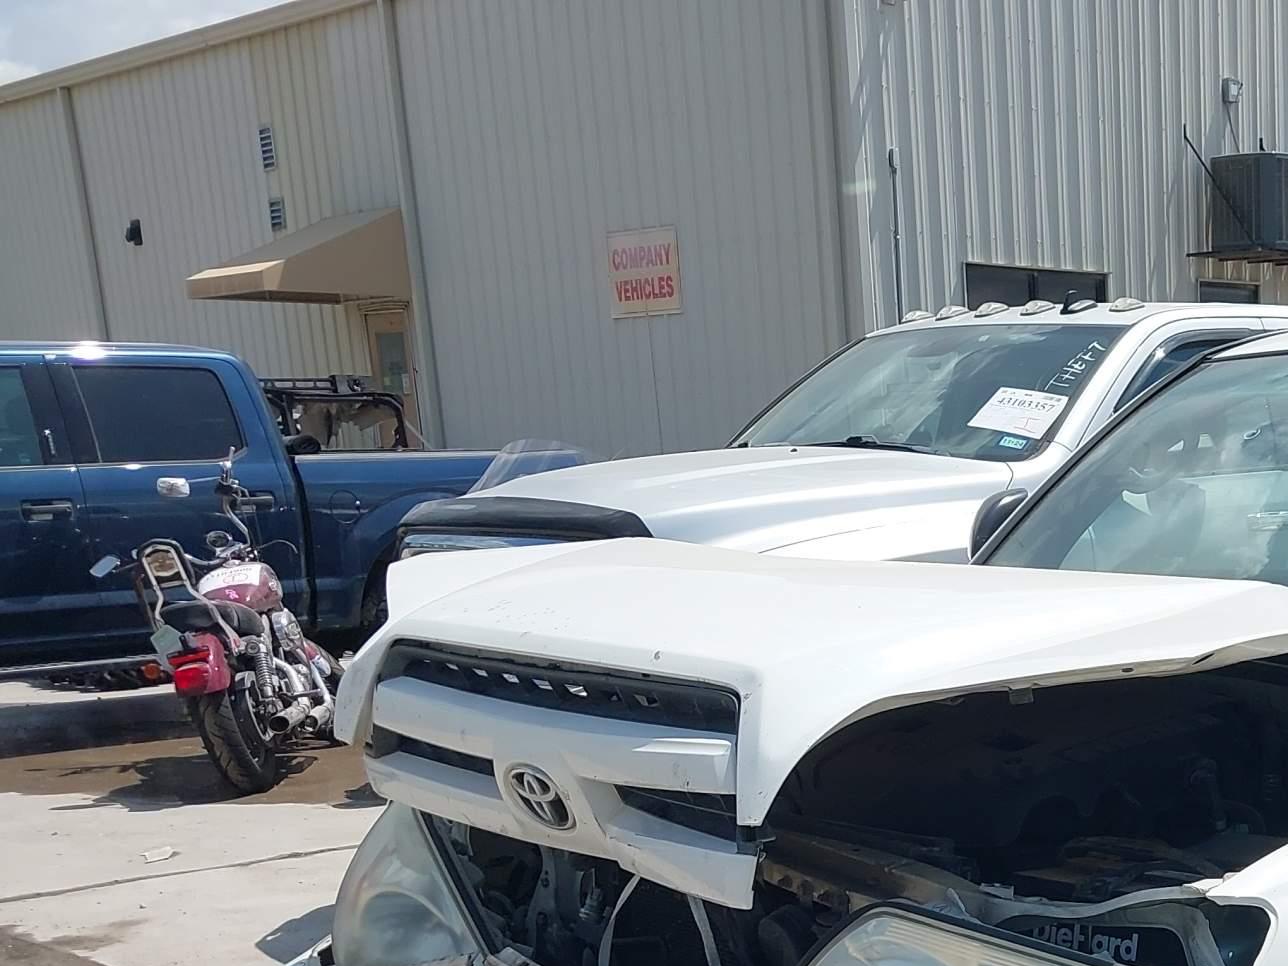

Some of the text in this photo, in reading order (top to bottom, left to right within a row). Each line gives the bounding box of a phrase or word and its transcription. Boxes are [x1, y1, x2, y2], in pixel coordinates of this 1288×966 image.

[612, 243, 671, 272] COMPANY
[615, 275, 674, 302] VEHICLES
[1044, 341, 1107, 390] THEFT
[997, 396, 1056, 413] 43103357
